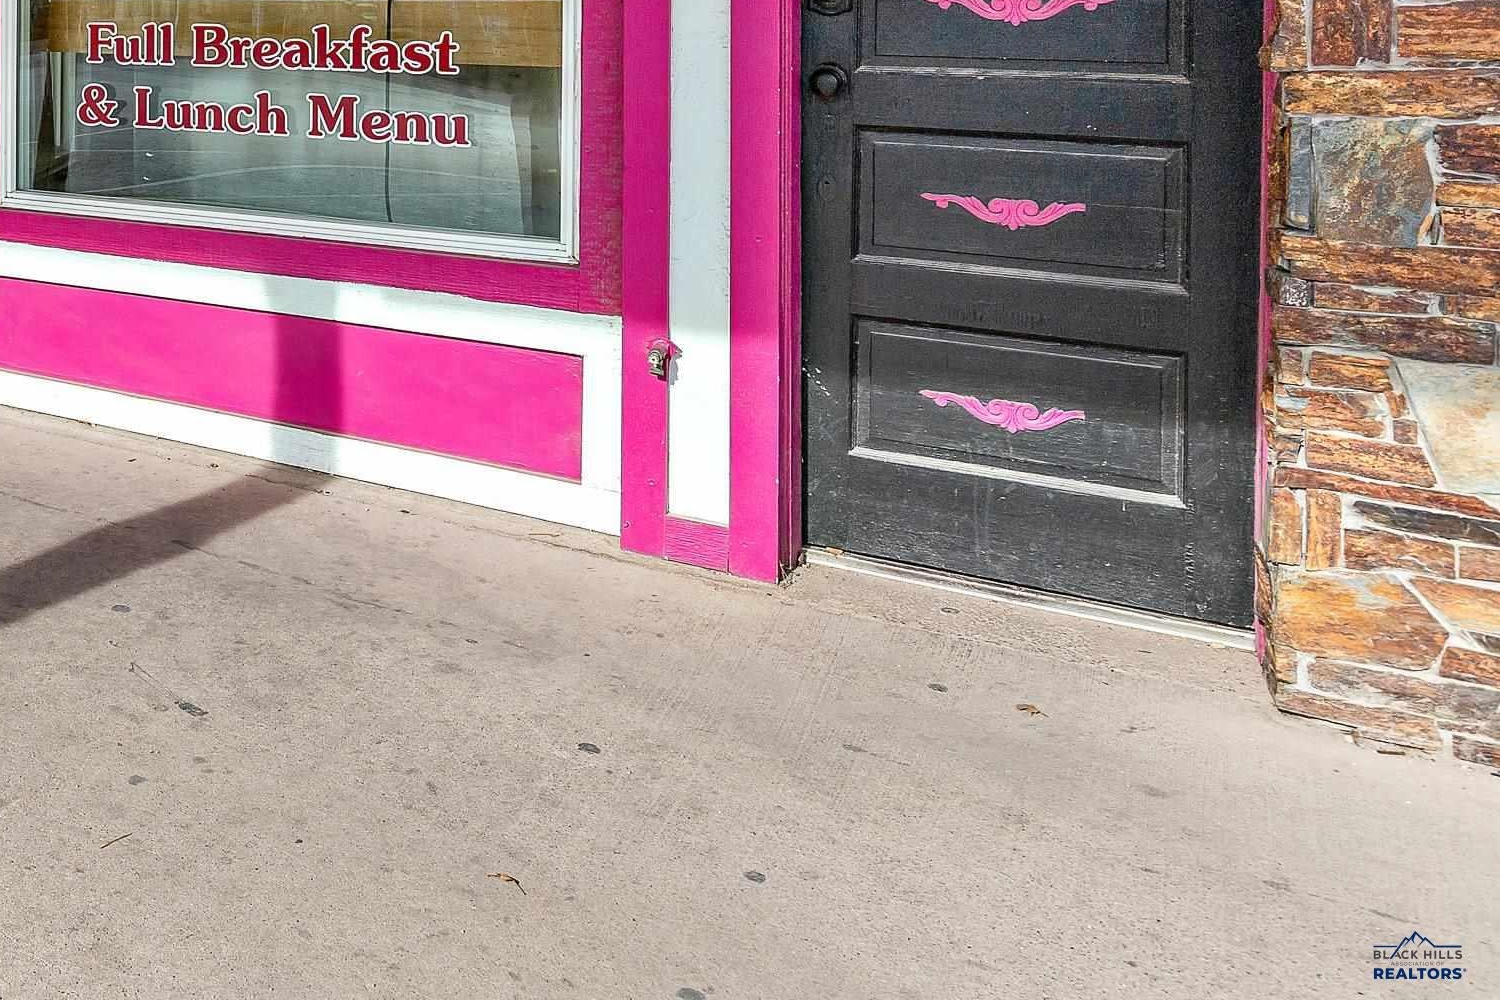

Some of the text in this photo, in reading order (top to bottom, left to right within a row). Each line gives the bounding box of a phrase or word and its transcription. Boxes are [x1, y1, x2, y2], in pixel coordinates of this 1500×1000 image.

[86, 22, 460, 75] Full Breakfast
[76, 82, 472, 148] & Lunch Menu
